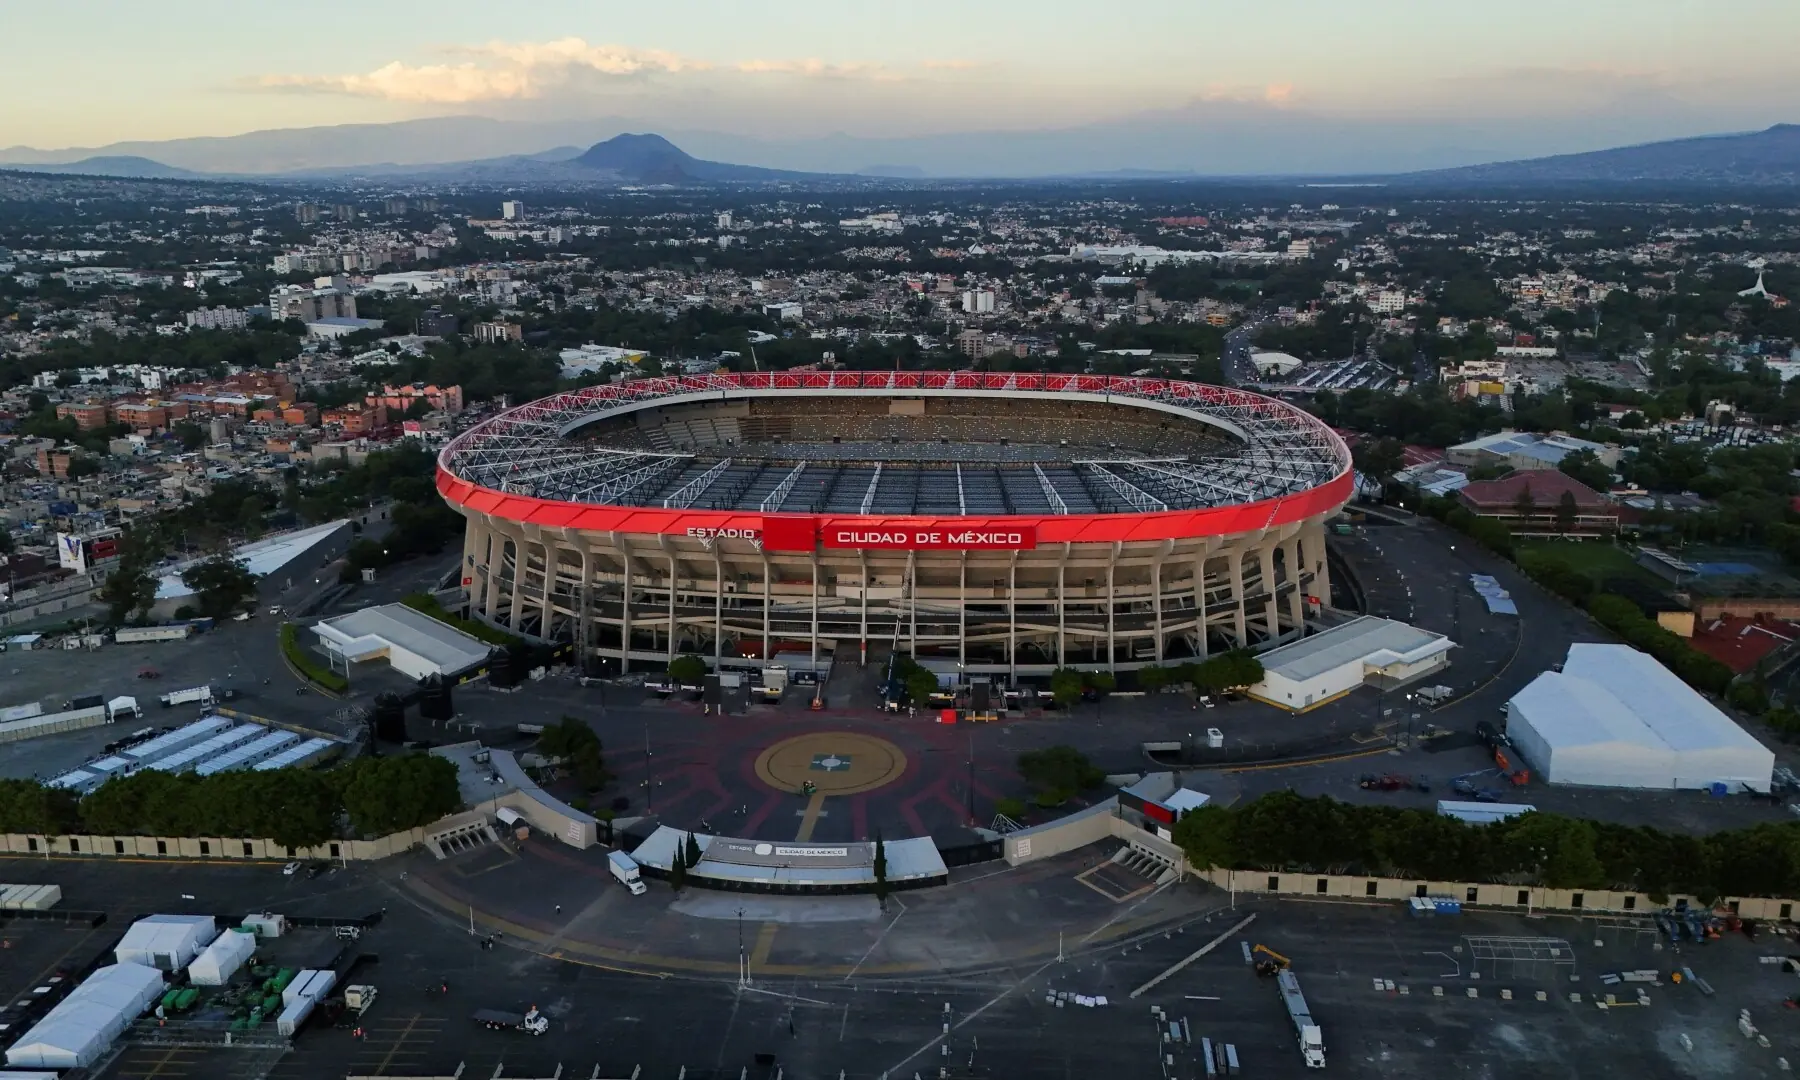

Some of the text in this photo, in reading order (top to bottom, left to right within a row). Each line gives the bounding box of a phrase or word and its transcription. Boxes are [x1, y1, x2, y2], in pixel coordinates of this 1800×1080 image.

[687, 527, 755, 539] ESTADIO
[837, 530, 1022, 544] CIUDAD DE MÉXICO
